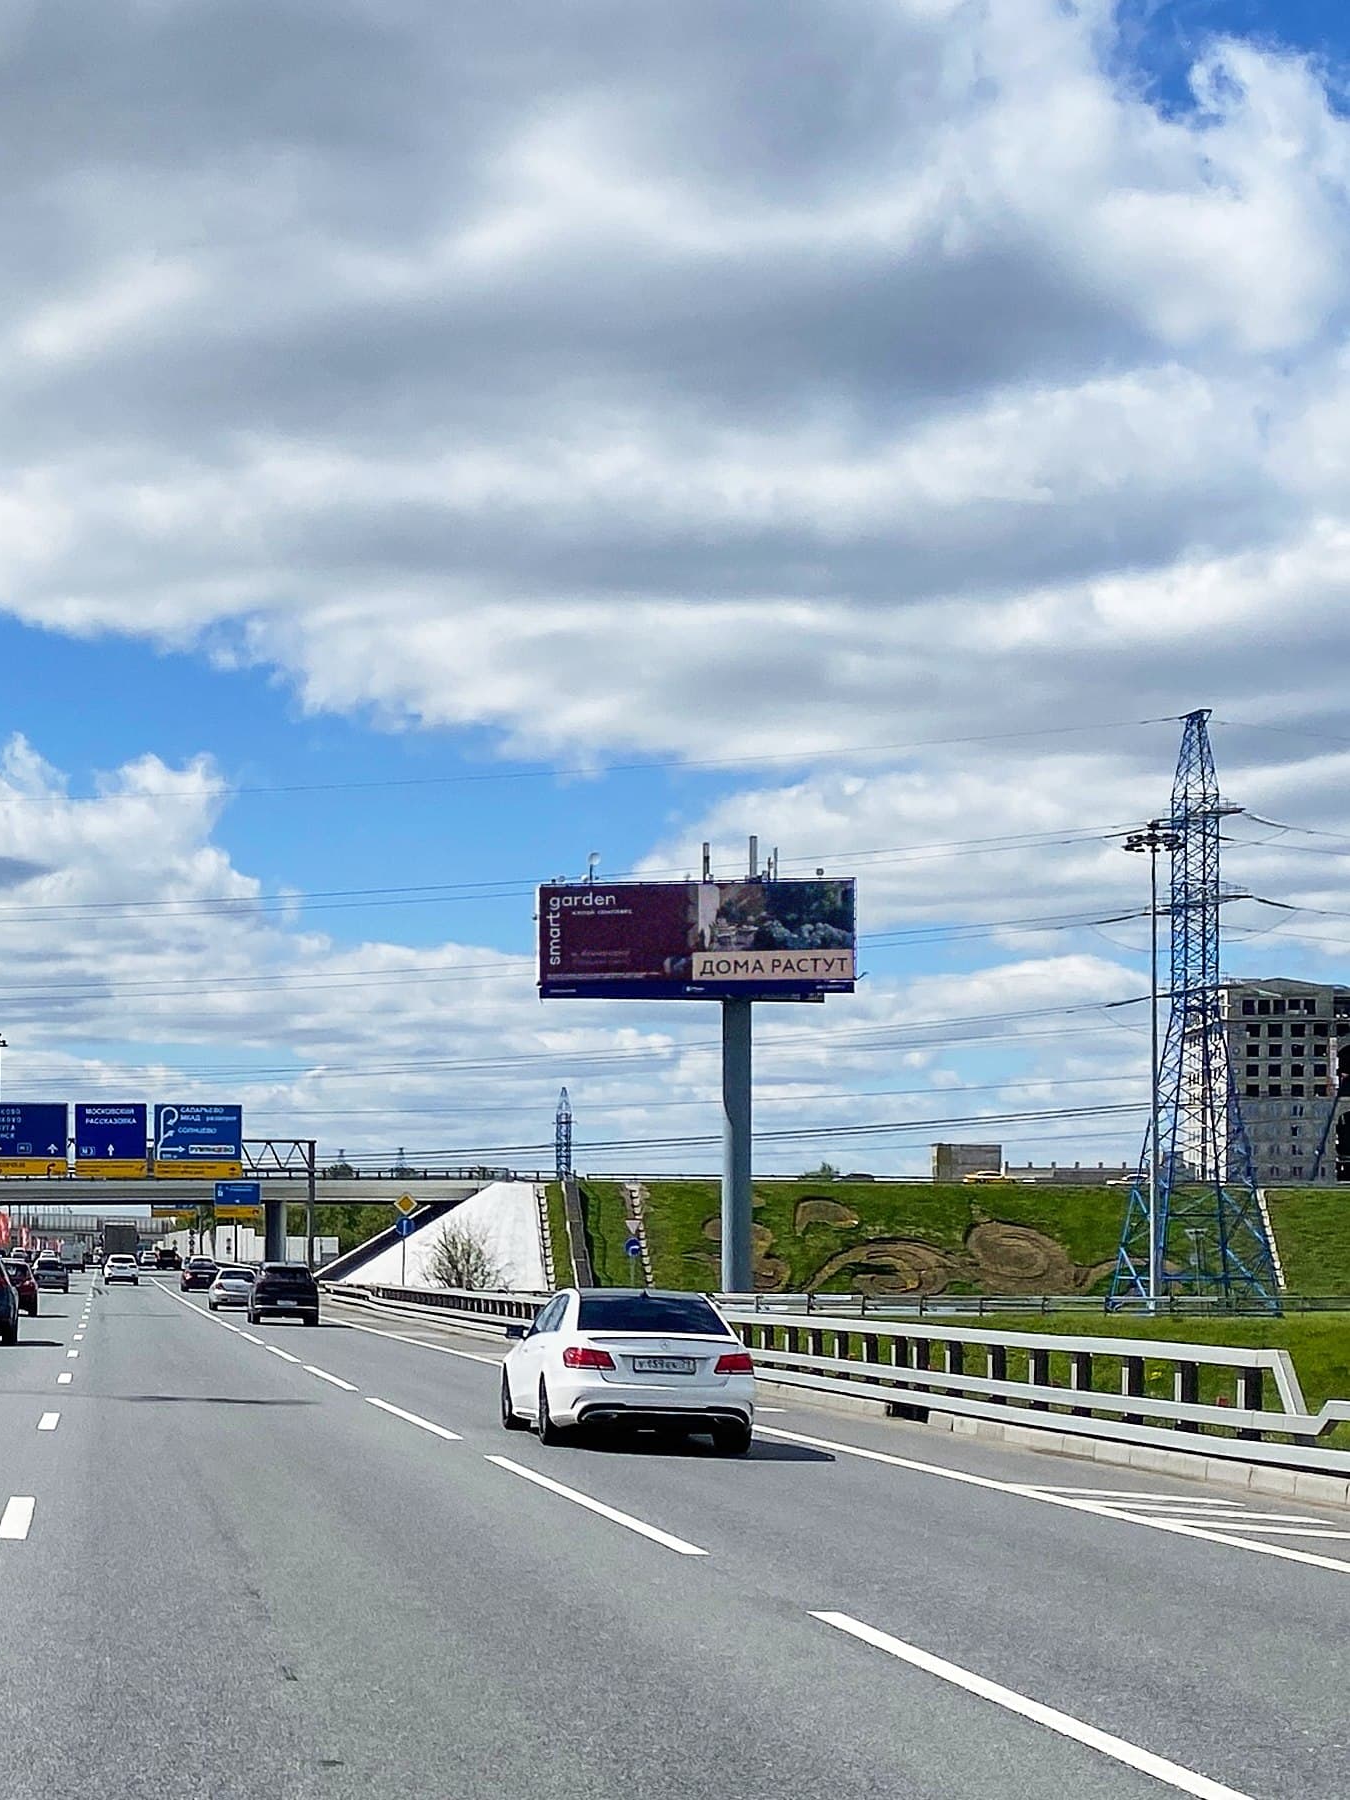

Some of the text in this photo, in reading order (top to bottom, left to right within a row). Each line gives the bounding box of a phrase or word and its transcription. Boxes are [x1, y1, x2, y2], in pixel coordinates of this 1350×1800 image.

[549, 890, 617, 911] garden
[546, 911, 562, 966] smart
[700, 957, 848, 976] ДОМА РАСТУТ
